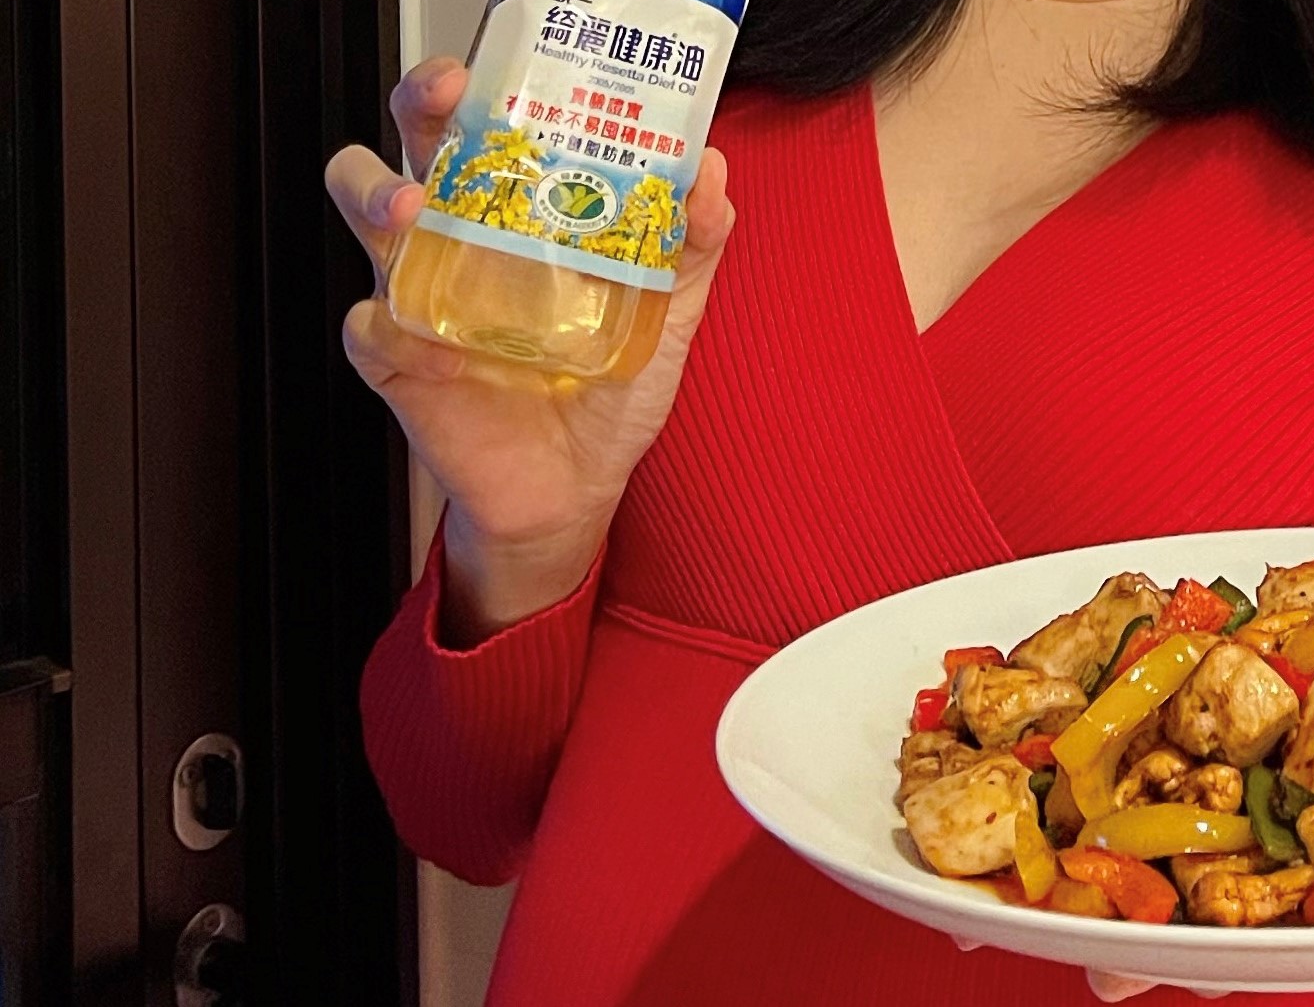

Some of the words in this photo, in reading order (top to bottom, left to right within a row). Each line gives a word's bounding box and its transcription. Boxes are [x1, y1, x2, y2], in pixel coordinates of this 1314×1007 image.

[534, 41, 589, 69] Healthy
[590, 58, 645, 83] Resetta
[647, 72, 676, 91] Diet
[678, 81, 697, 97] Oil
[541, 5, 705, 82] 綺麗健康油
